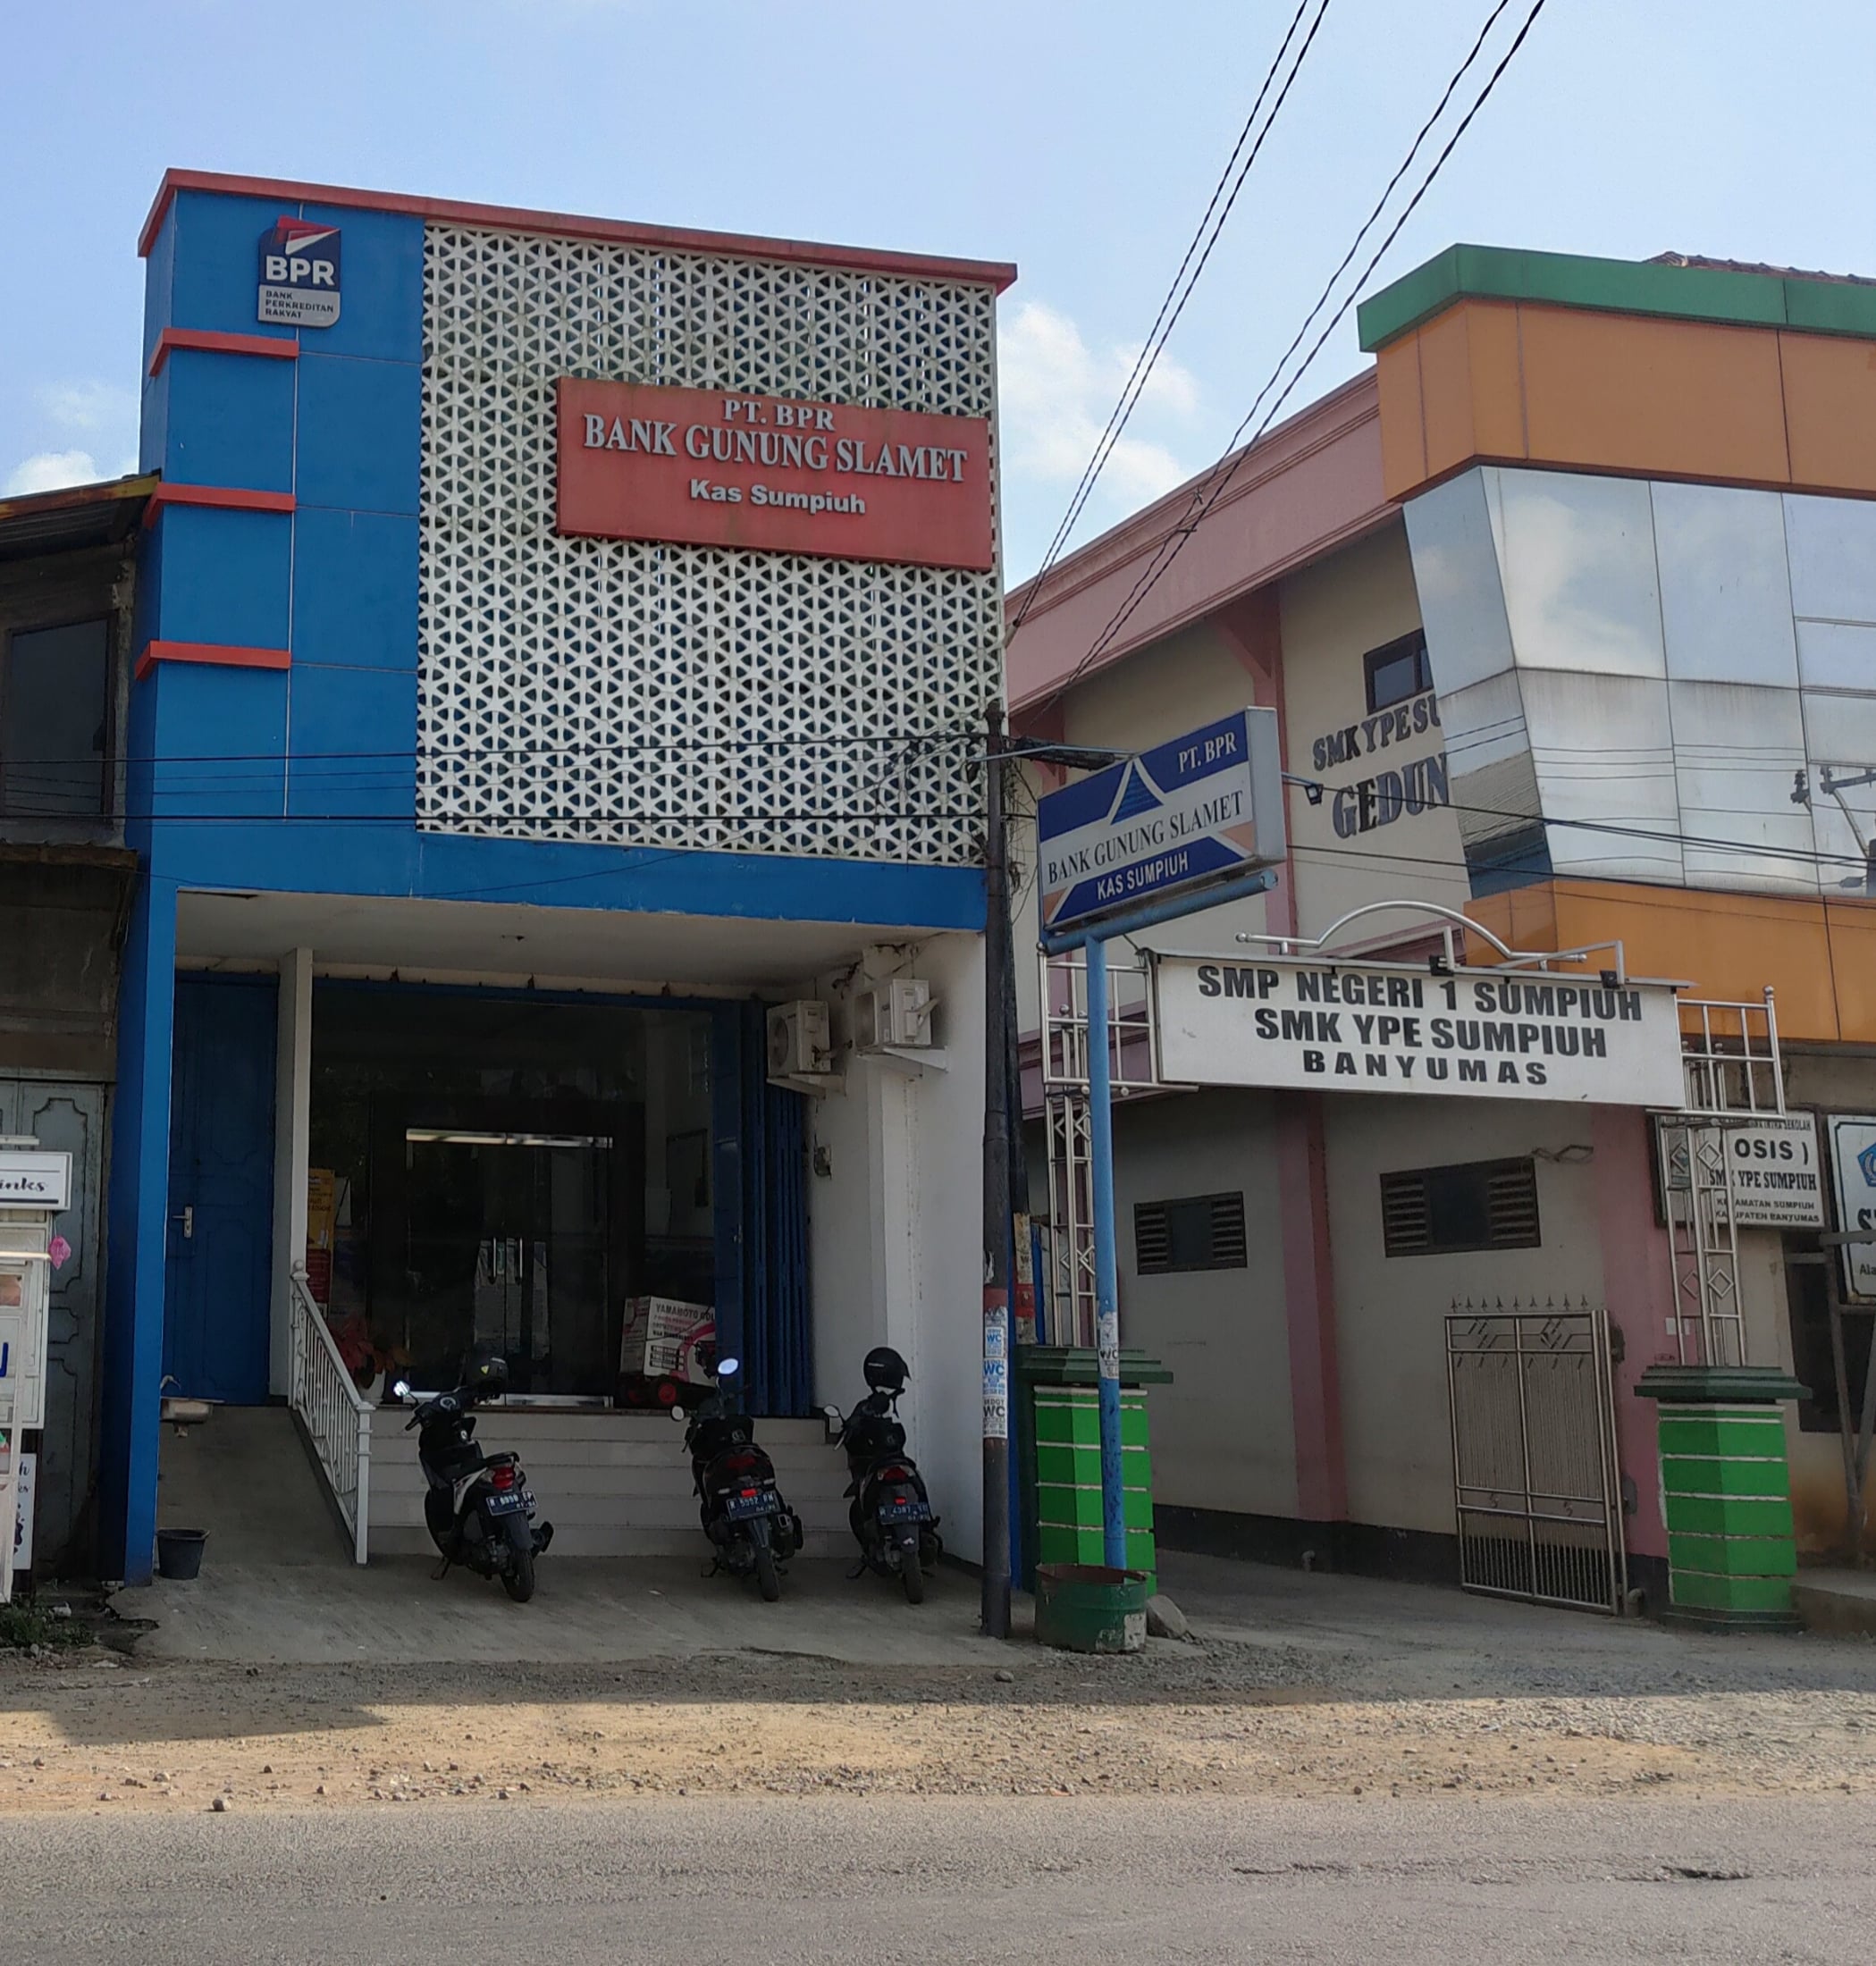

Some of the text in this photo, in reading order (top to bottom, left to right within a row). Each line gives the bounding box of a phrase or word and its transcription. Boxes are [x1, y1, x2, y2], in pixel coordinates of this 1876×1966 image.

[266, 256, 334, 285] BPR
[265, 299, 333, 313] PERKREDITAN
[266, 290, 293, 299] BANK
[265, 308, 301, 318] RAKYAT
[723, 399, 836, 432] PT. BPR
[583, 414, 968, 483] BANK GUNUNG SLAMET
[690, 479, 866, 515] Kas Sumpiuh
[1178, 731, 1238, 774] PT. BPR
[1313, 725, 1361, 771] SMK
[1361, 705, 1411, 753] YPE
[1047, 789, 1244, 885] BANK GUNUNG SLAMET
[1097, 852, 1190, 901] KAS SUMPIUH
[1198, 964, 1642, 1021] SMP NEGERI 1 SUMPIUH
[1255, 1007, 1608, 1058] SMK YPE SUMPIUH
[1302, 1048, 1548, 1086] BANYUMAS
[1734, 1138, 1794, 1161] OSIS
[1737, 1170, 1762, 1188] YPE
[1763, 1172, 1817, 1191] SUMPIUH
[1773, 1200, 1814, 1210] SUMPIUH
[987, 1334, 1002, 1342] WC
[983, 1364, 1005, 1375] WC
[983, 1406, 1005, 1417] WC
